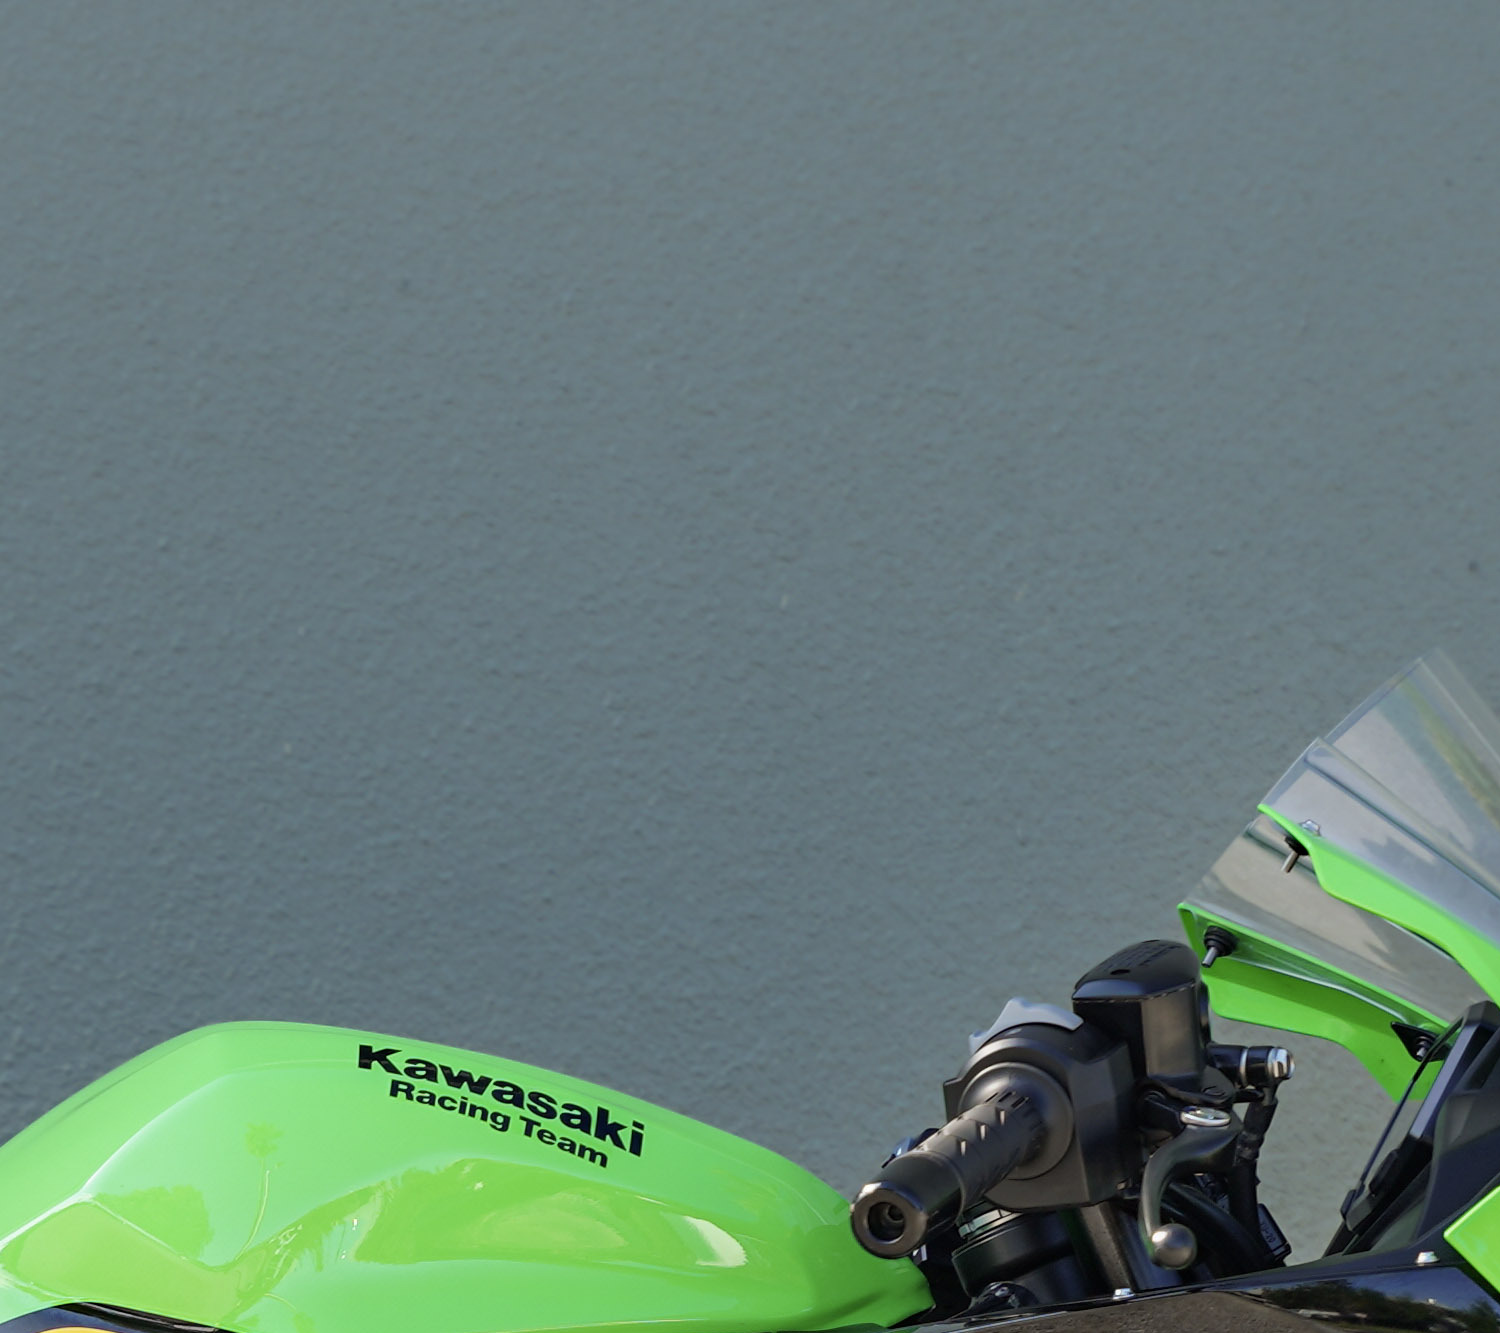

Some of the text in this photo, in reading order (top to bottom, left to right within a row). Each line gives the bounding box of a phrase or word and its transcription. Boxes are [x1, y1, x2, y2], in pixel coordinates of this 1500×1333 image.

[357, 1044, 645, 1157] Kawasaki
[389, 1079, 608, 1168] Racing Team
